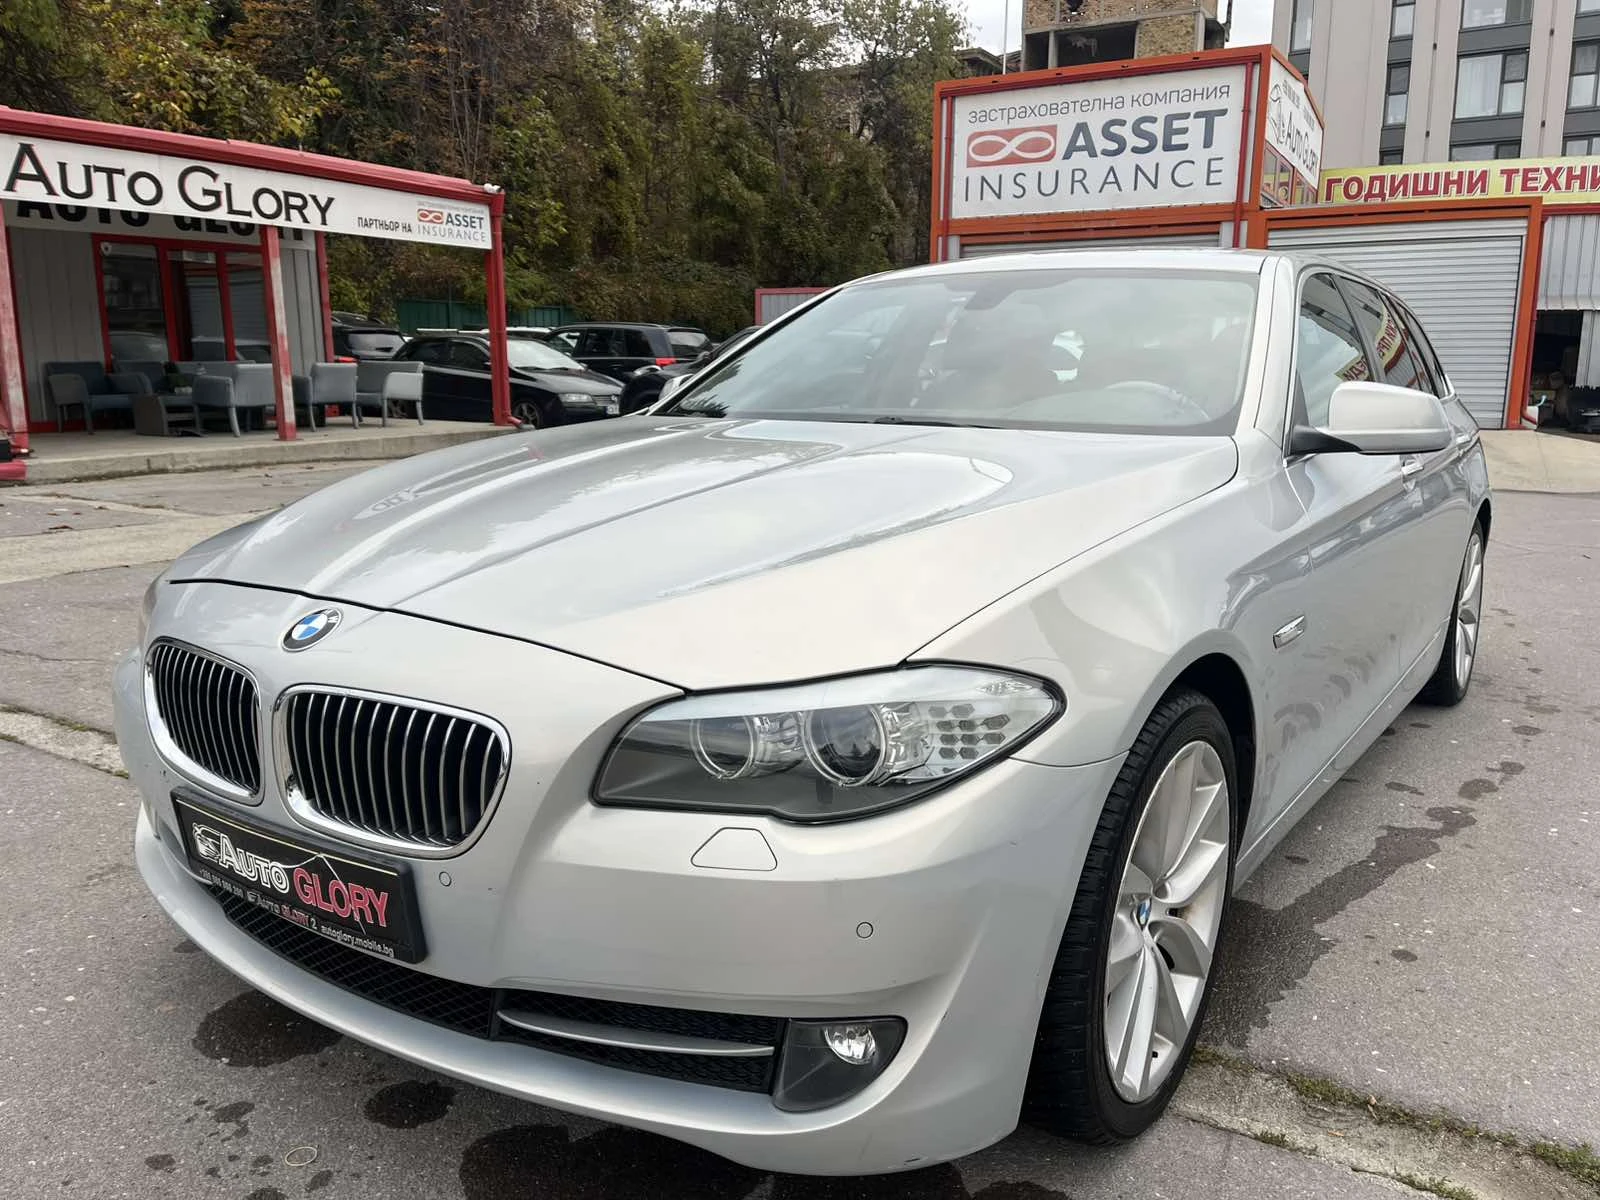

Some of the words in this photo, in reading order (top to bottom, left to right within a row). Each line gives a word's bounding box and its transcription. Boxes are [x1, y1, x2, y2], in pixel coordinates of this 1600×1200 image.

[968, 93, 1125, 126] застрахователна
[1131, 84, 1230, 108] компания
[1062, 108, 1228, 161] ASSET
[4, 142, 163, 206] AUTO
[178, 165, 335, 226] GLORY
[965, 157, 1224, 202] INSURANCE
[1324, 168, 1490, 203] ГОДИШНИ
[357, 216, 400, 232] ПАРТНЬОР
[402, 223, 412, 233] НА
[417, 224, 486, 242] INSURANCE
[445, 212, 484, 229] ASSET
[219, 834, 290, 893] AUTO
[293, 868, 388, 927] GLORY
[310, 917, 318, 930] 2
